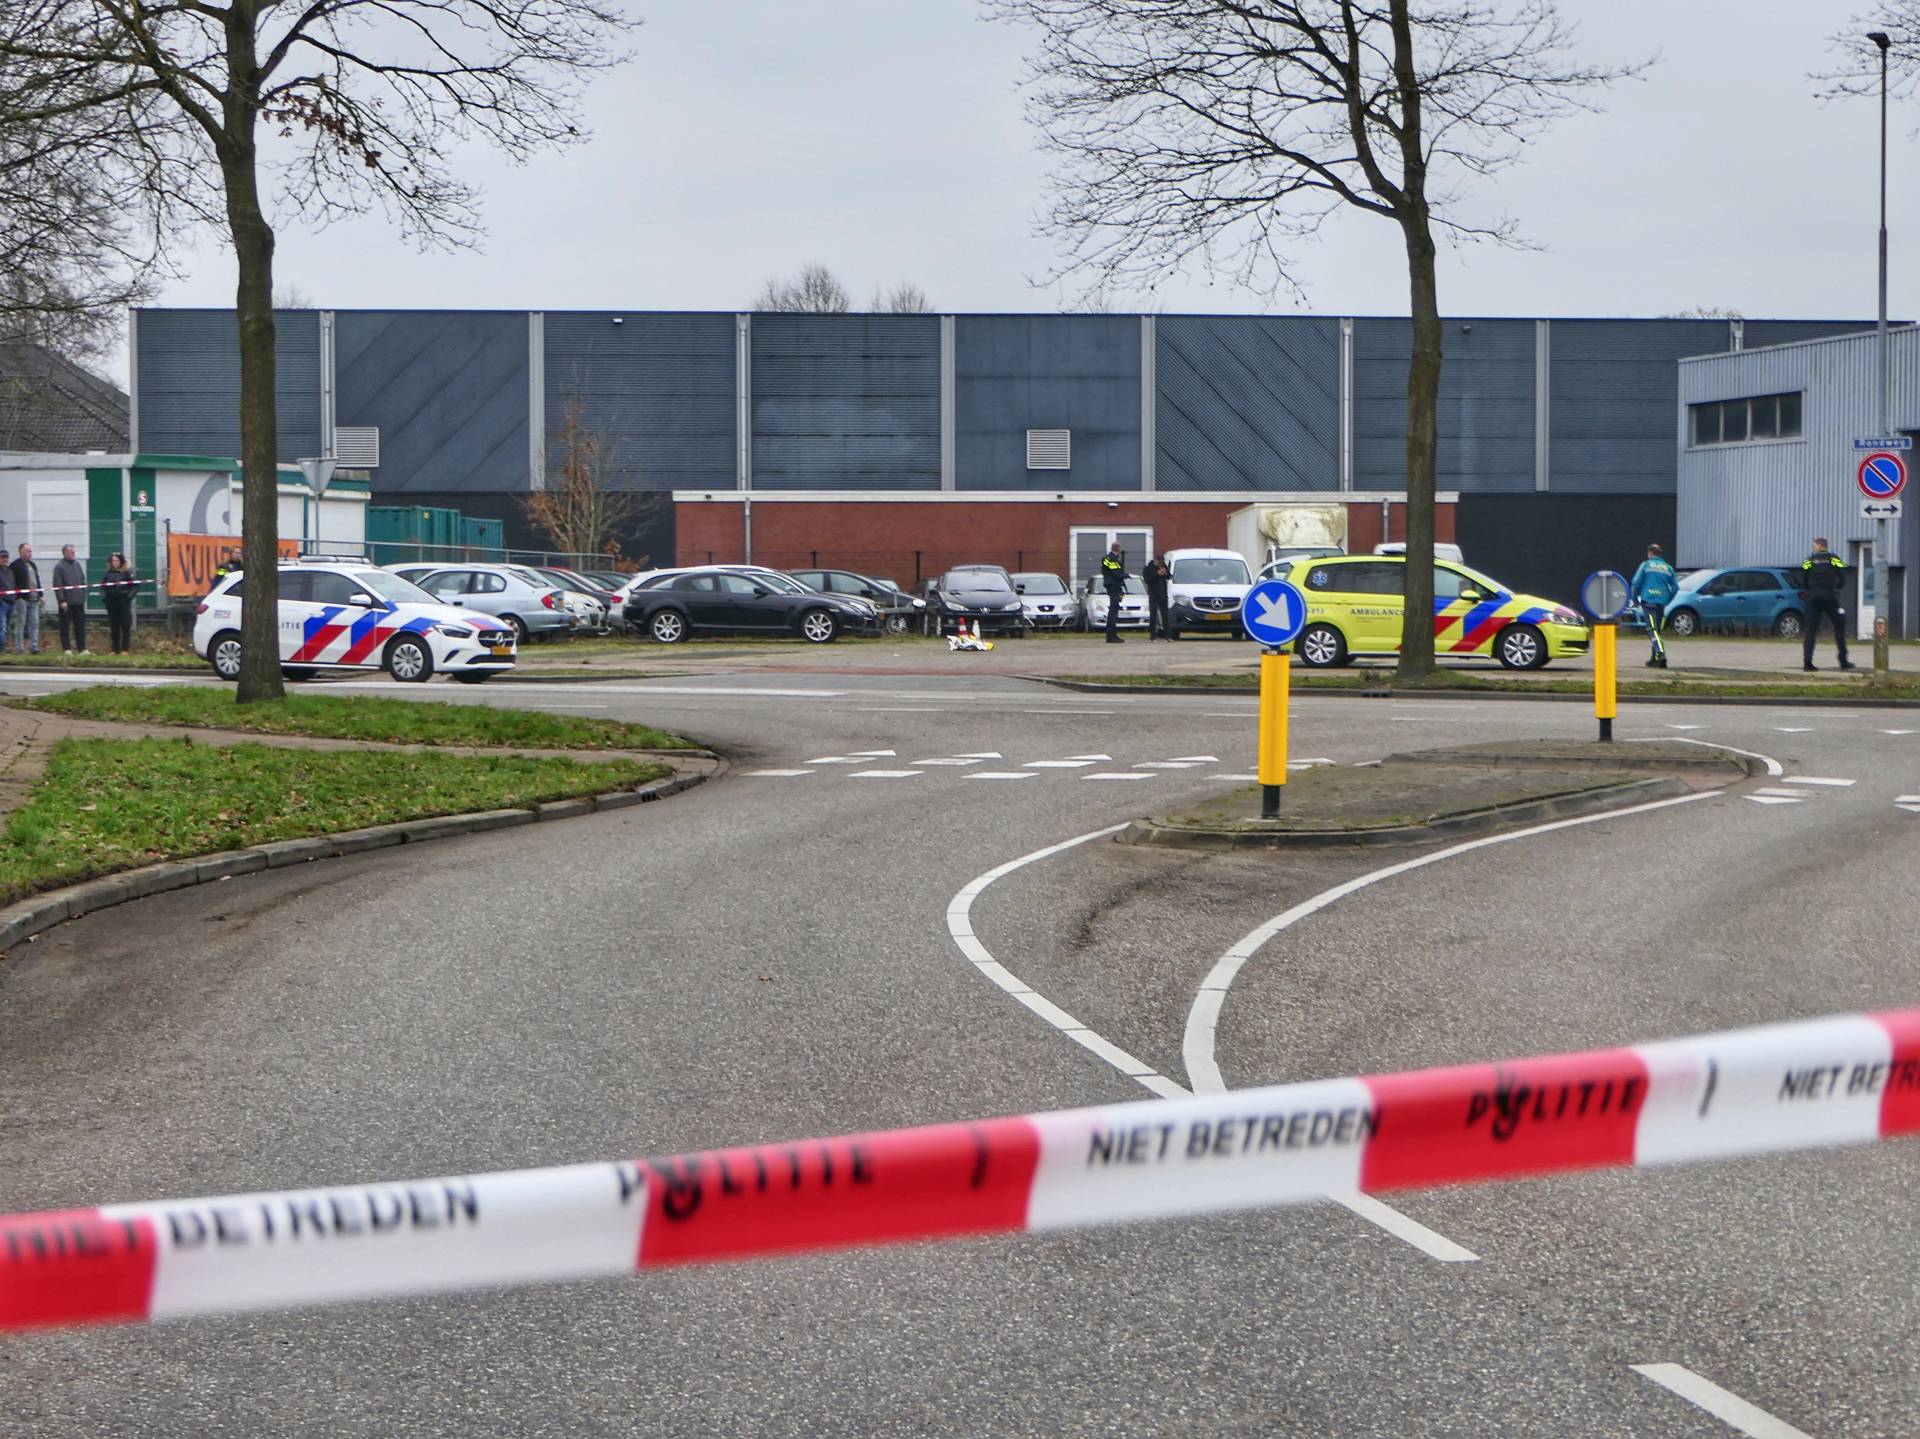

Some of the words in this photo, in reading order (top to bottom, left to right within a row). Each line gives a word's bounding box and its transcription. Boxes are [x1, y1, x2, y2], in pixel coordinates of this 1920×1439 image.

[1350, 608, 1406, 616] AMBULANCE
[1778, 1066, 1844, 1101] NIET
[1846, 1059, 1920, 1097] BETR
[1087, 1125, 1175, 1169] NIET
[1185, 1106, 1384, 1159] BETREDEN
